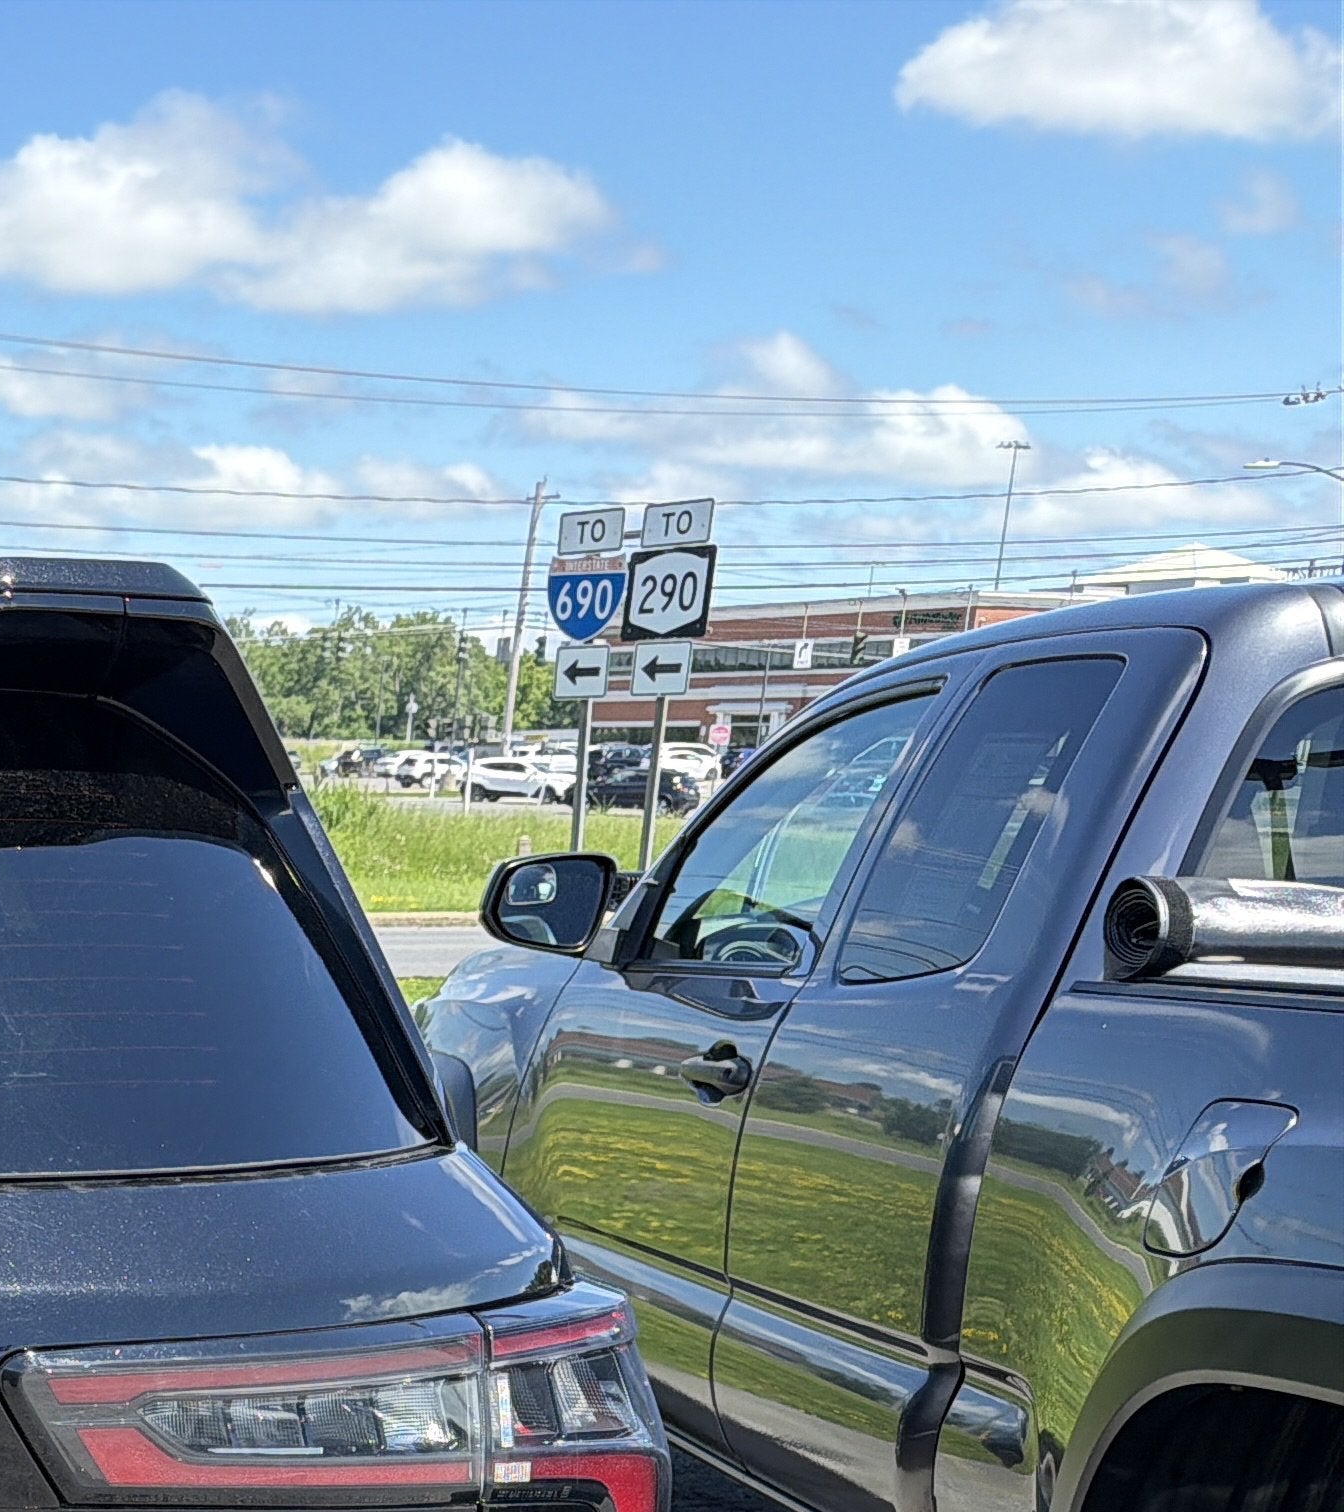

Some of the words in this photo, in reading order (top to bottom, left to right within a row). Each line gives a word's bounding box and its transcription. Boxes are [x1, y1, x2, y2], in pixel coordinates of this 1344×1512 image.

[577, 518, 606, 545] TO
[662, 510, 693, 537] TO
[565, 558, 610, 571] INTERSTATE
[555, 578, 612, 621] 690
[638, 571, 698, 615] 290
